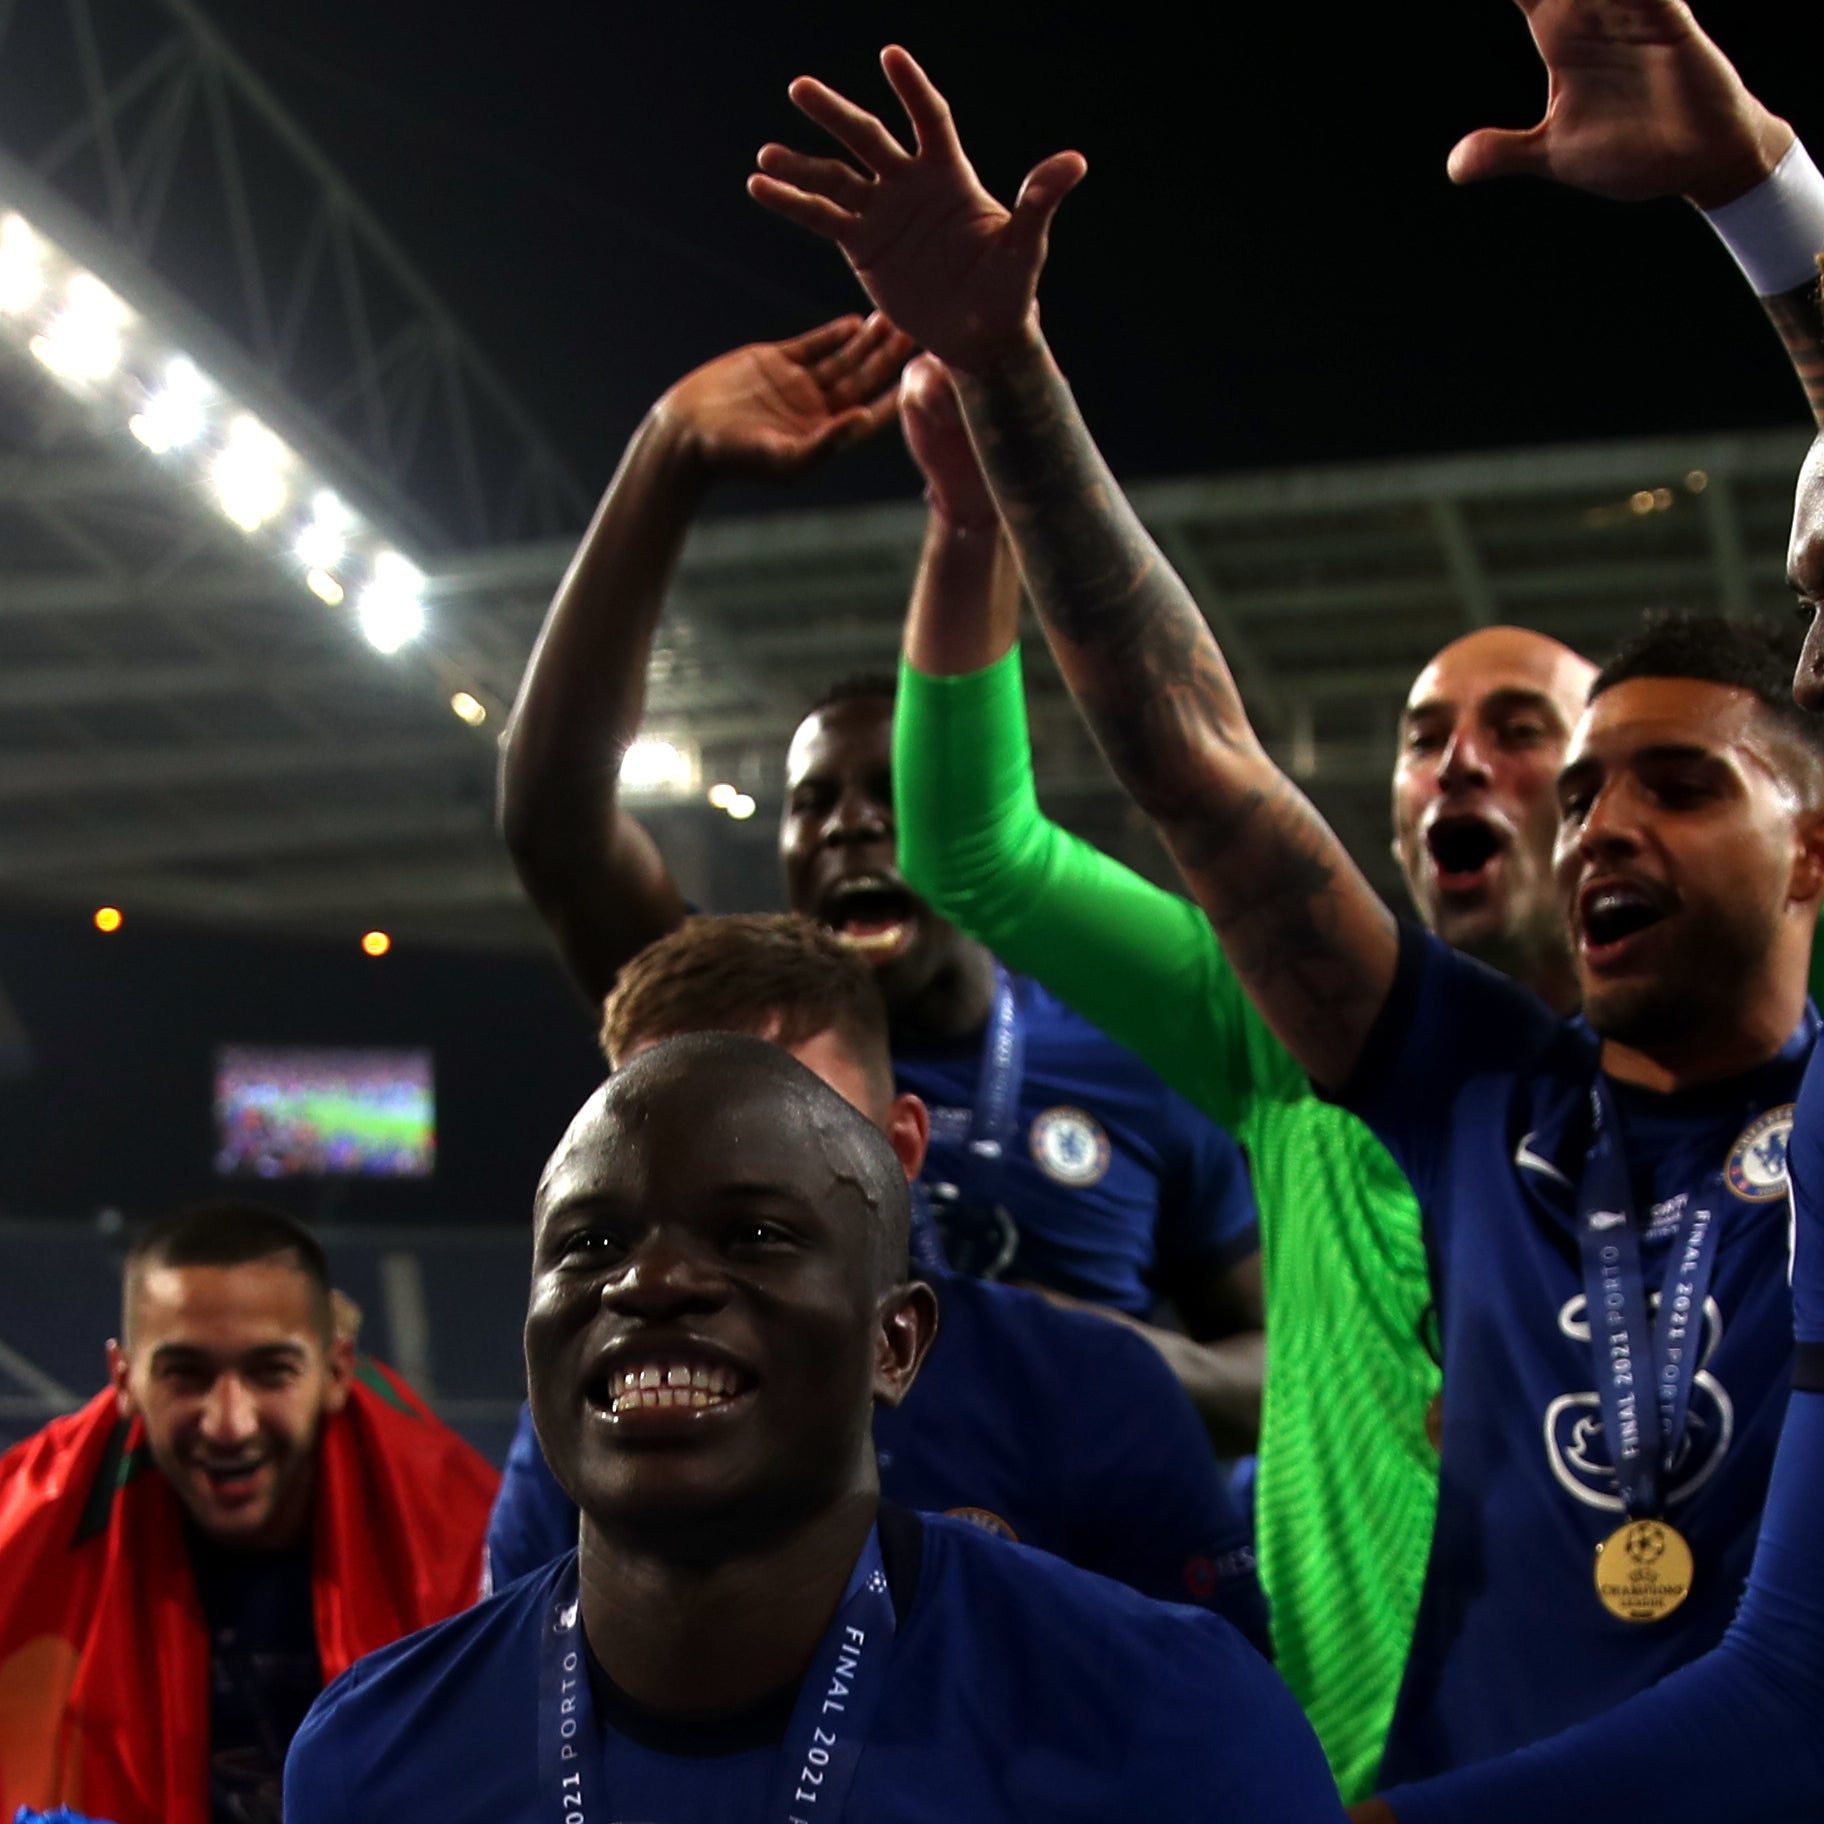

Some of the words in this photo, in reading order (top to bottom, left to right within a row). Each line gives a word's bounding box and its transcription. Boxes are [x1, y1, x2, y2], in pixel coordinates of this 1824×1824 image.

[1679, 1209, 1712, 1274] FINAL
[1599, 1244, 1626, 1327] PORTO
[1667, 1281, 1695, 1340] 2021
[1608, 1329, 1635, 1389] 2021
[1616, 1391, 1640, 1461] FINAL
[559, 1651, 579, 1761] PORTO
[821, 1624, 866, 1715] FINAL
[794, 1725, 837, 1804] 2021
